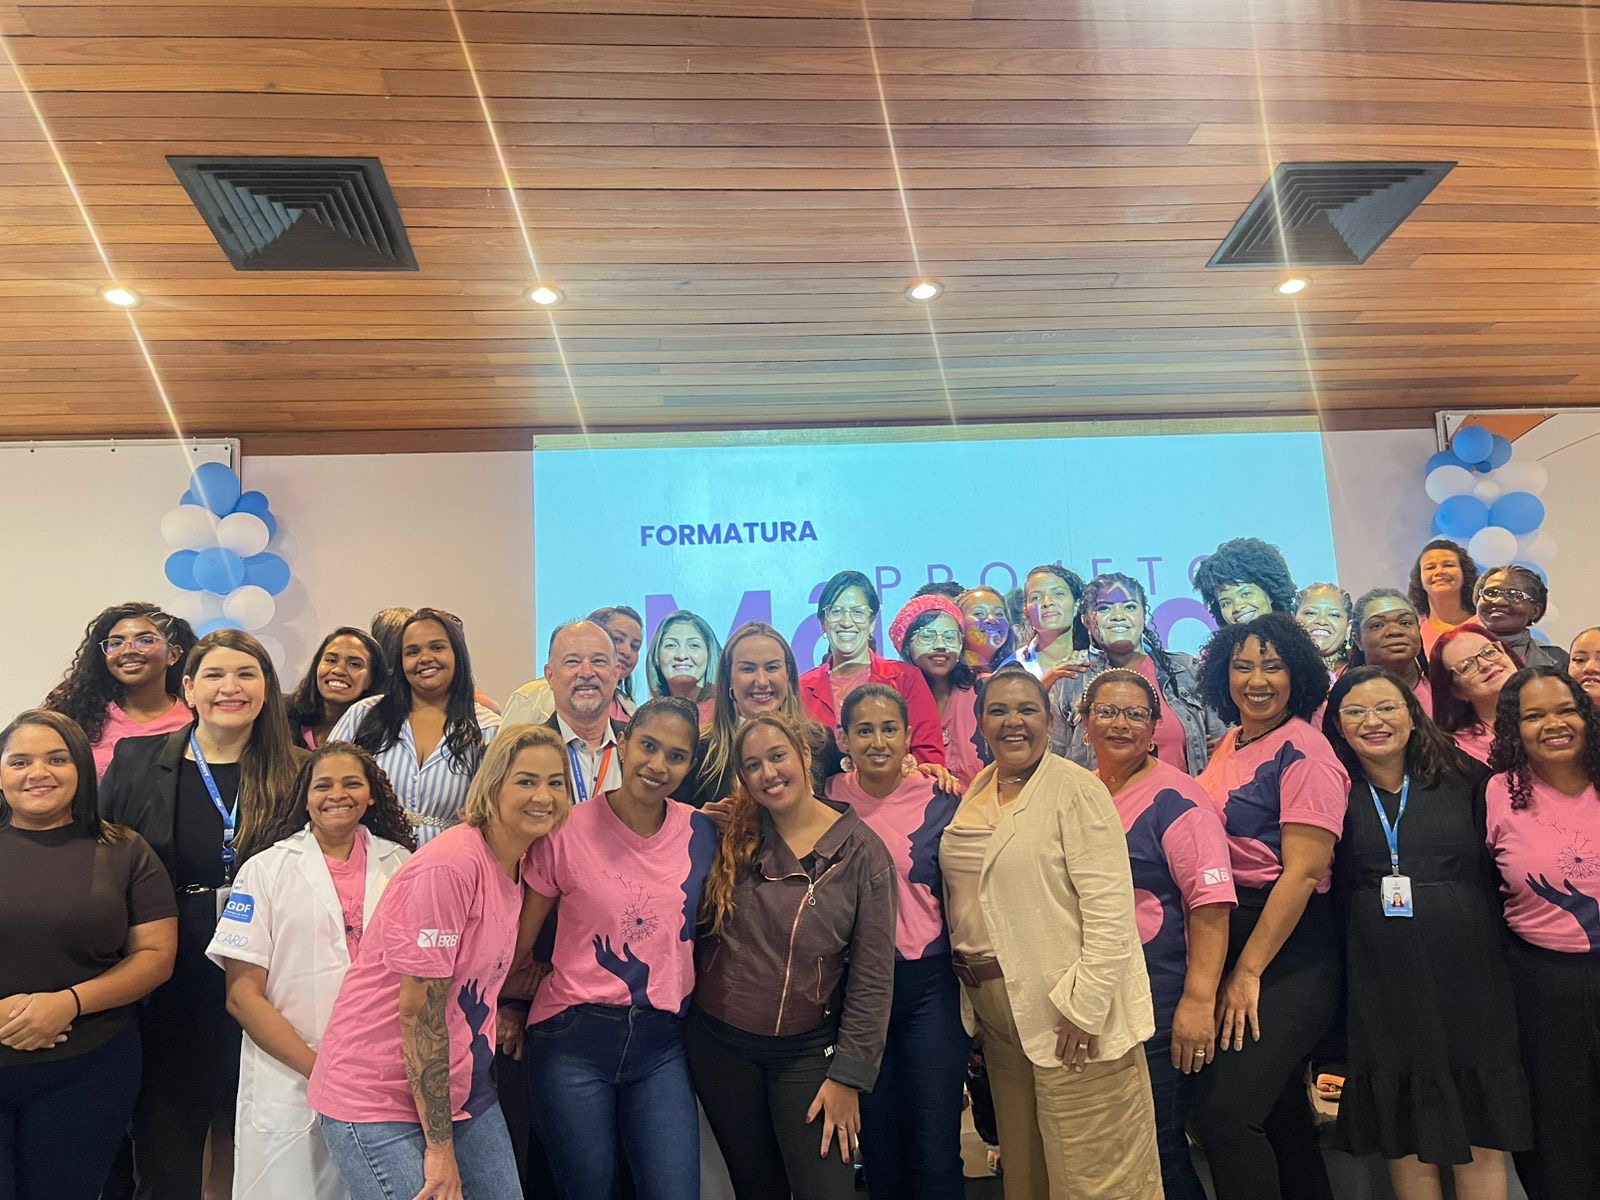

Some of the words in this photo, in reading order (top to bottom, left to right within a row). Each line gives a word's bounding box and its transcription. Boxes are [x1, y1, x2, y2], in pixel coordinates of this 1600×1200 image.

[640, 520, 818, 547] FORMATURA
[226, 901, 252, 913] GDF
[437, 934, 459, 947] BRB
